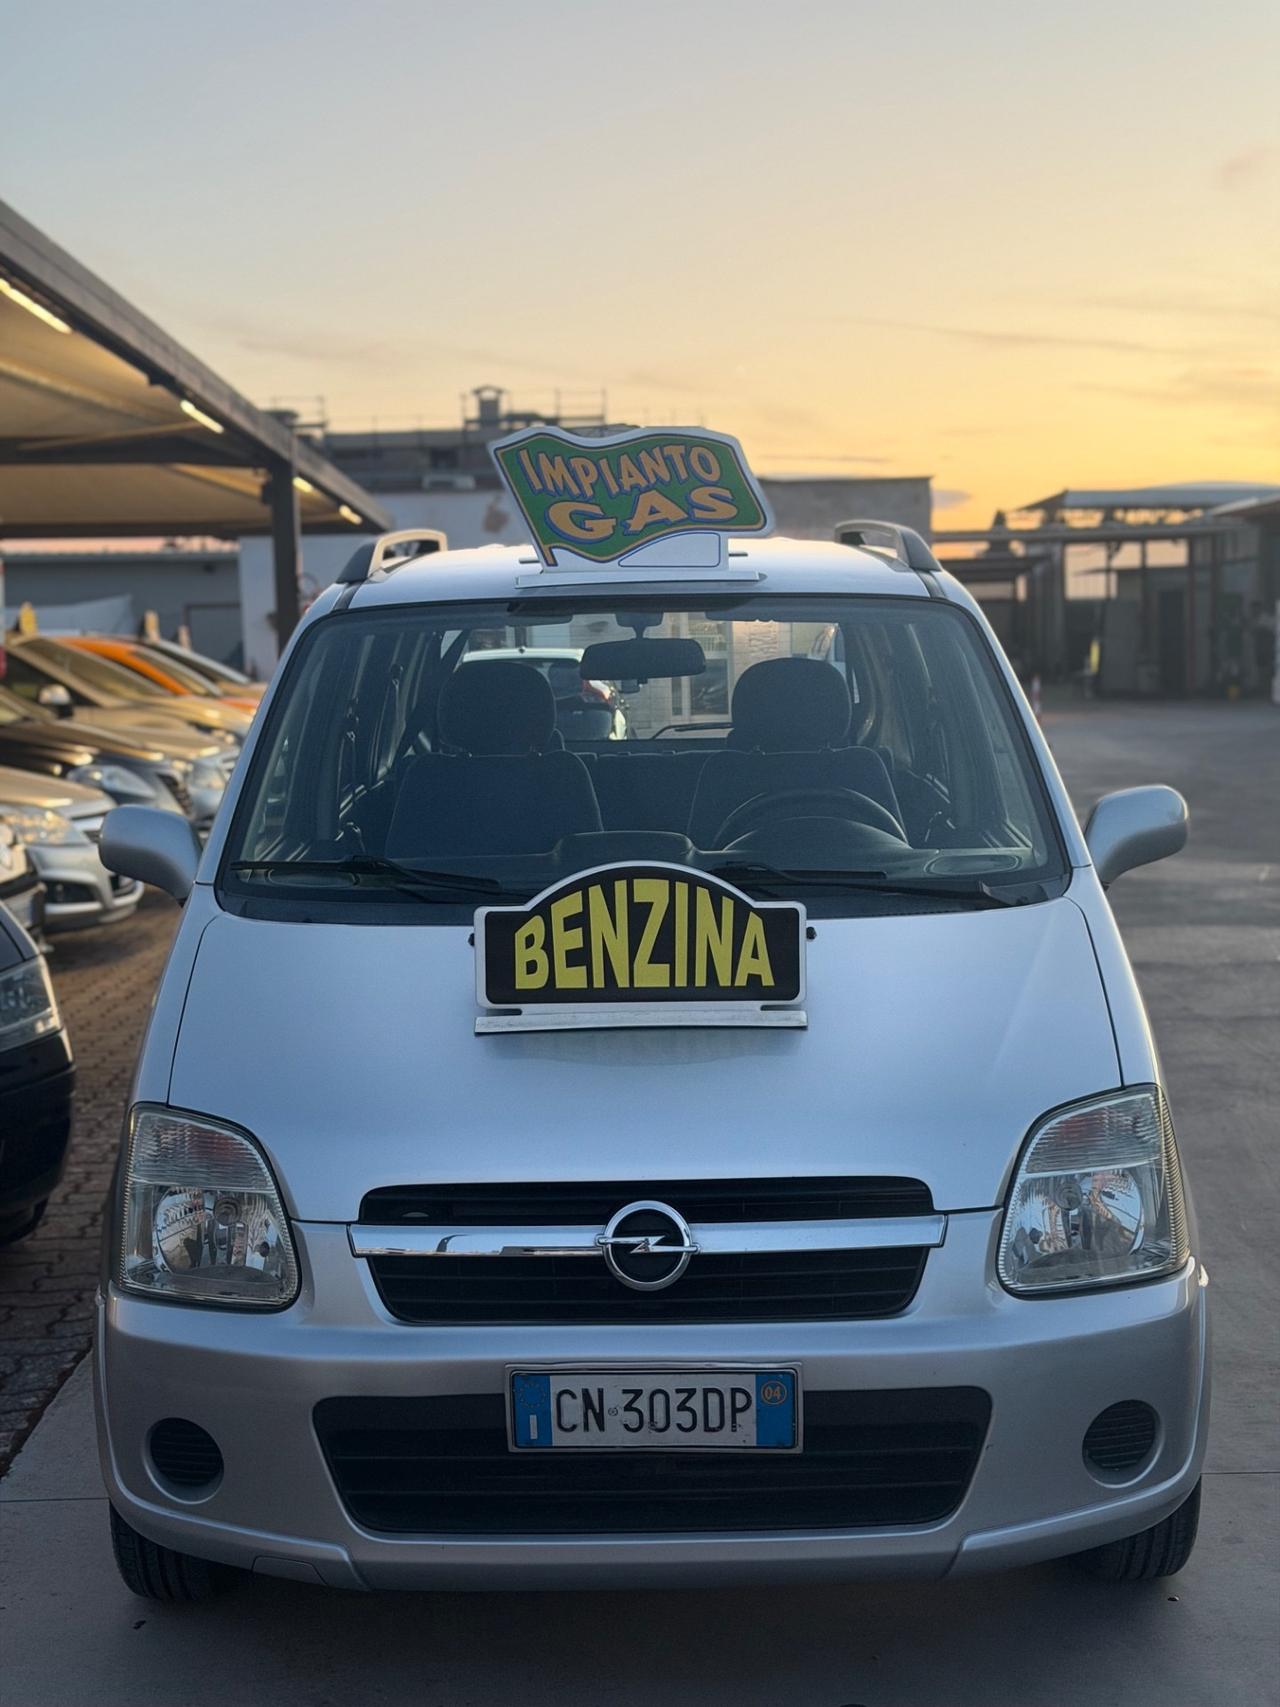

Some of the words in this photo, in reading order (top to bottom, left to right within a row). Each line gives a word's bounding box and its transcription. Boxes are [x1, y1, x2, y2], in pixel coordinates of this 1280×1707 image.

[517, 445, 721, 499] IMPIANTO
[544, 486, 738, 544] GAS
[514, 878, 775, 990] BENZINA
[556, 1387, 606, 1433] CN
[621, 1386, 753, 1433] 303DP
